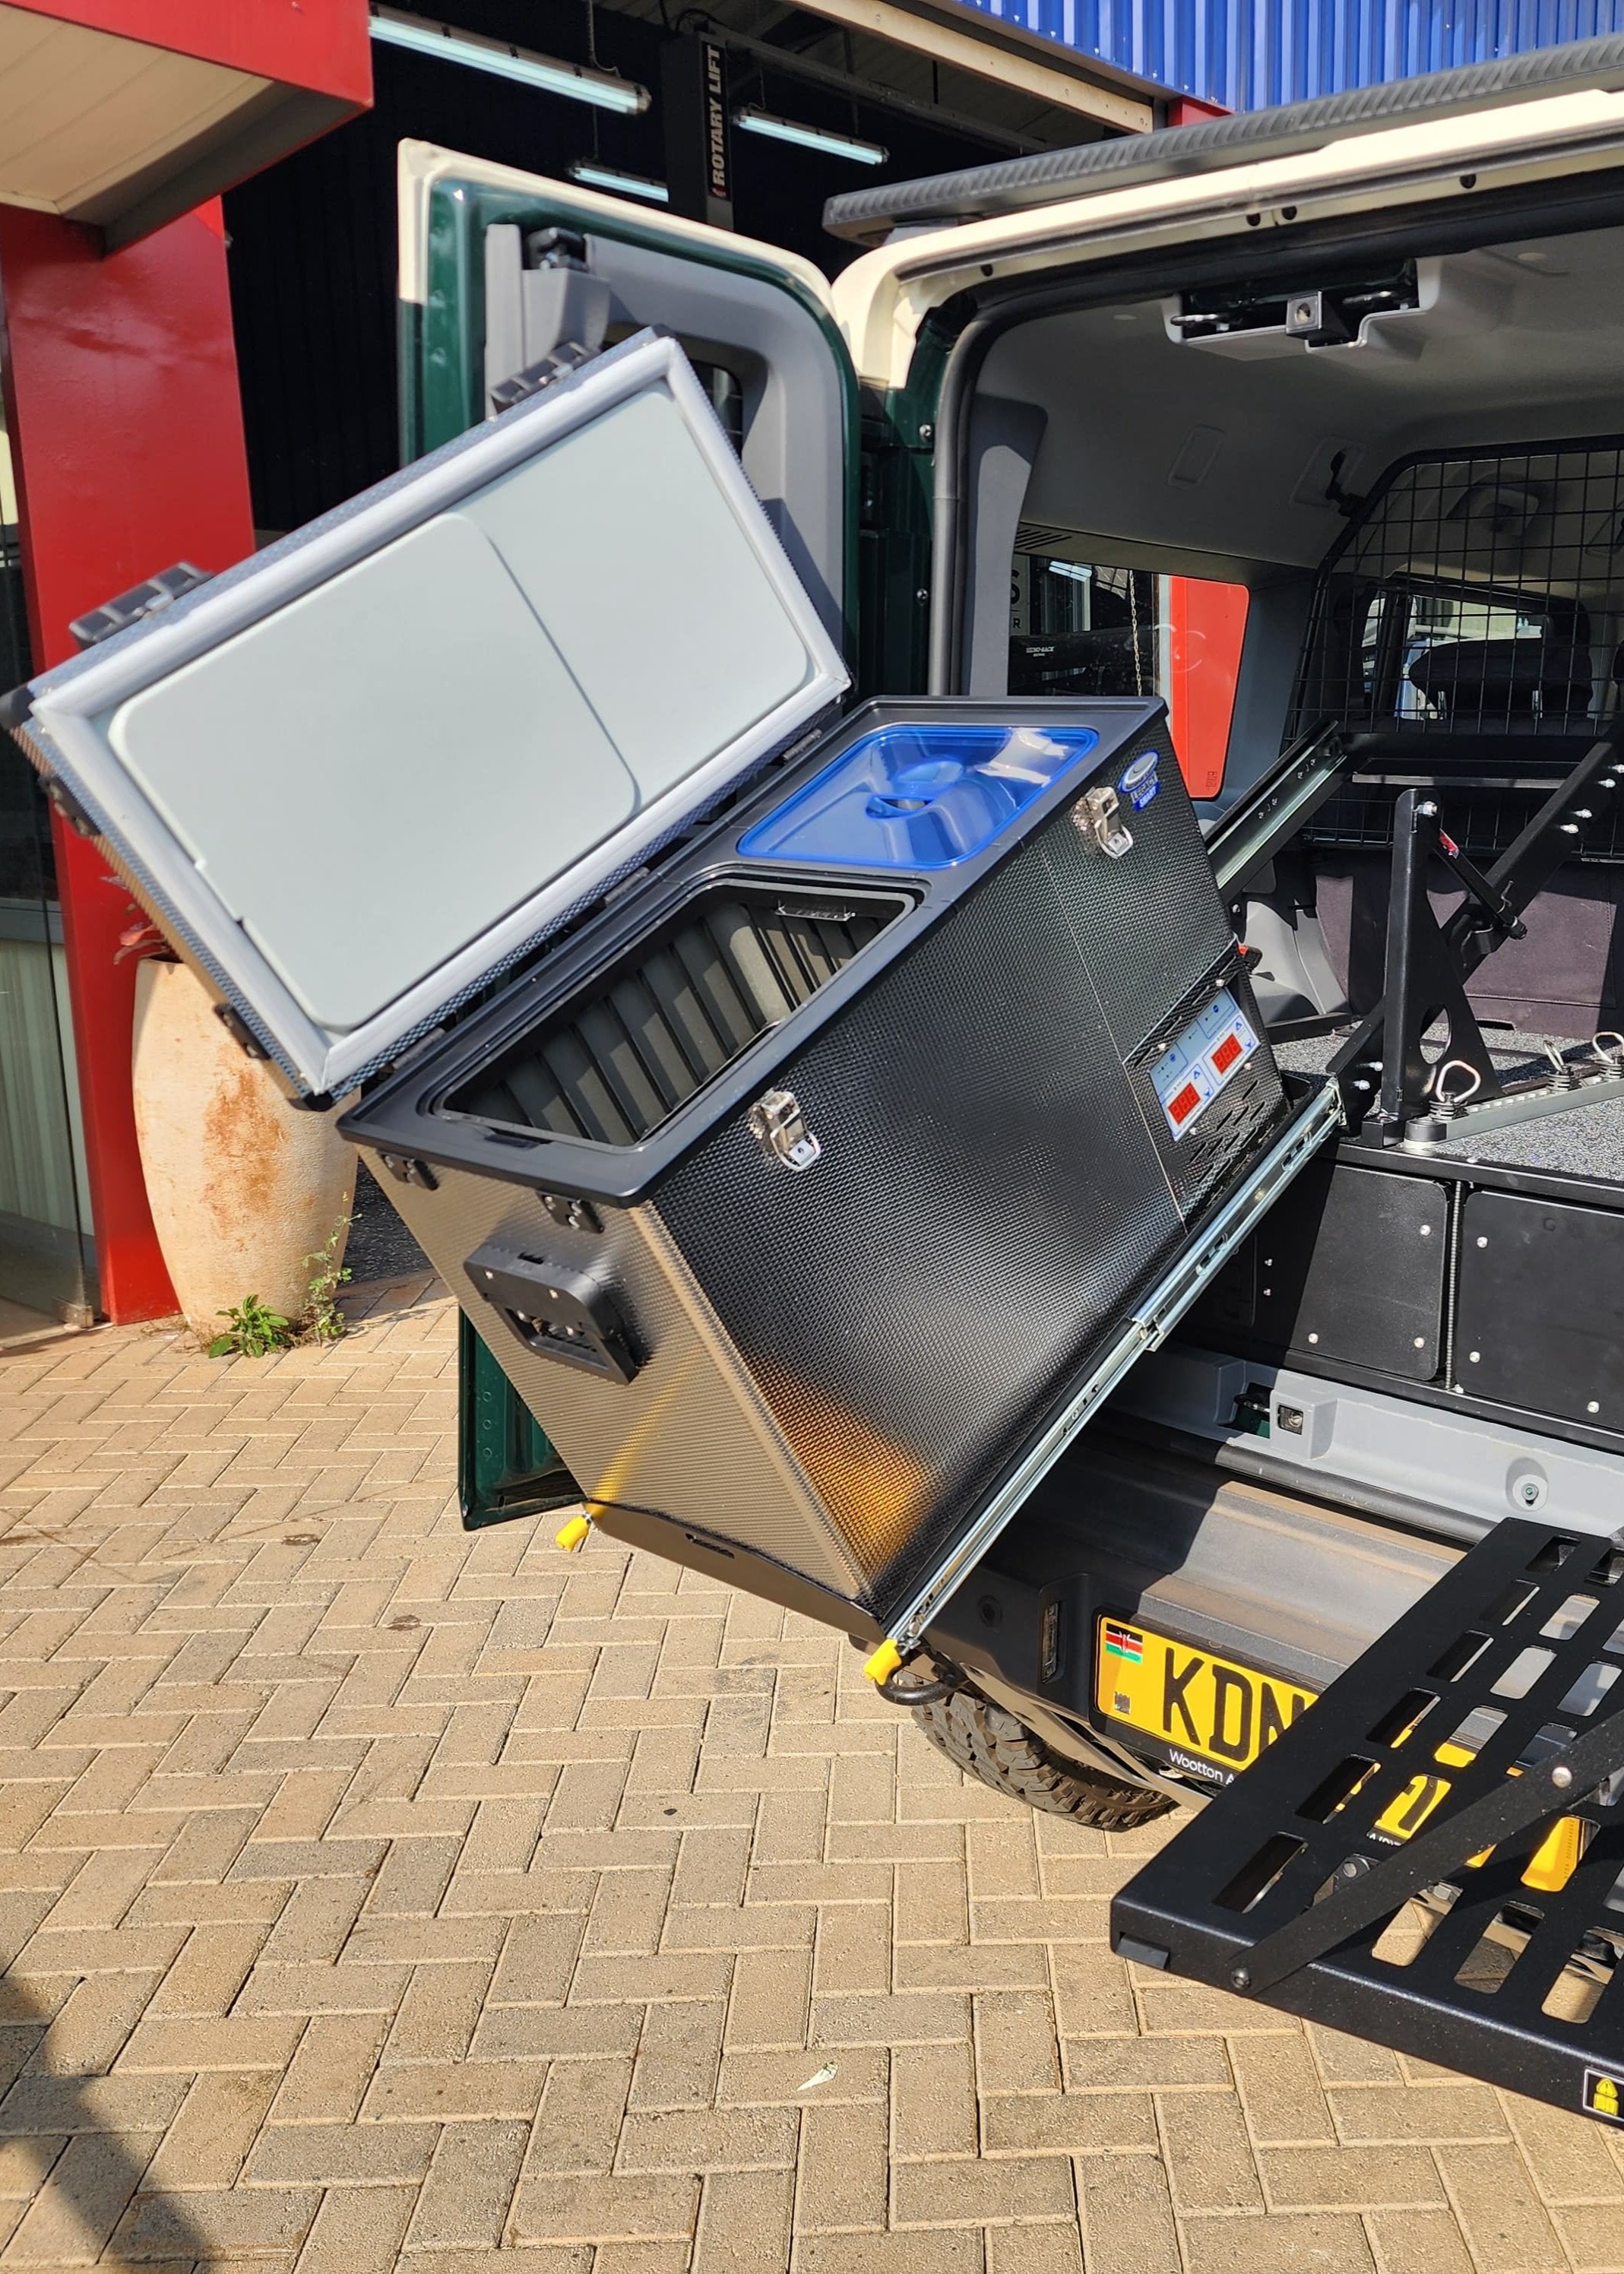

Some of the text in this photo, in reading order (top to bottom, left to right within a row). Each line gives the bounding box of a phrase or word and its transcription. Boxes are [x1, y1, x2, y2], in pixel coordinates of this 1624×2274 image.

[708, 45, 726, 187] ROTARY LIFT
[1132, 773, 1157, 800] LEGACY
[1163, 1647, 1306, 1762] KDN
[1169, 1748, 1223, 1782] Wootton
